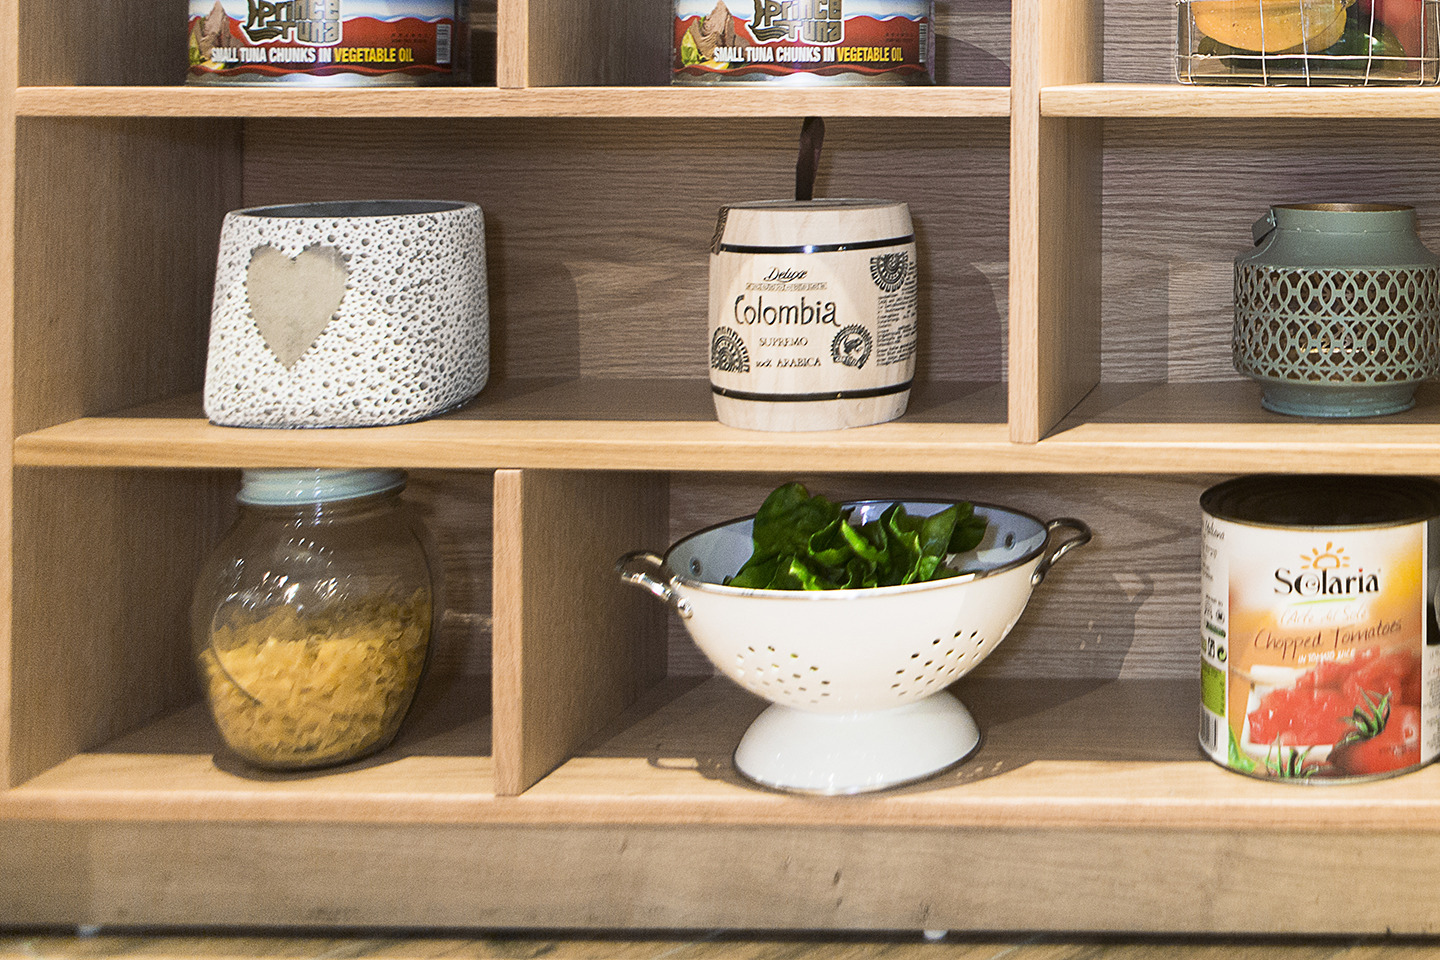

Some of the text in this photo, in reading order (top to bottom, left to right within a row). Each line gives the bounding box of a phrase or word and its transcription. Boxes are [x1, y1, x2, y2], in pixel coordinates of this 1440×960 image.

[266, 18, 342, 44] Tuna
[773, 19, 843, 43] Tuna
[211, 46, 414, 63] SMALL TUNA CHUNKS IN VEGETABLE OIL
[714, 46, 904, 63] SMALL TUNA CHUNKS IN VEGETABLE OIL
[763, 267, 808, 283] Deluxe
[734, 294, 841, 327] Colombia
[759, 337, 808, 347] SUPREMO
[776, 357, 821, 368] ARABICA
[1274, 567, 1380, 597] Solaria
[1254, 628, 1324, 660] Chopped
[1332, 618, 1402, 650] Tomatoes
